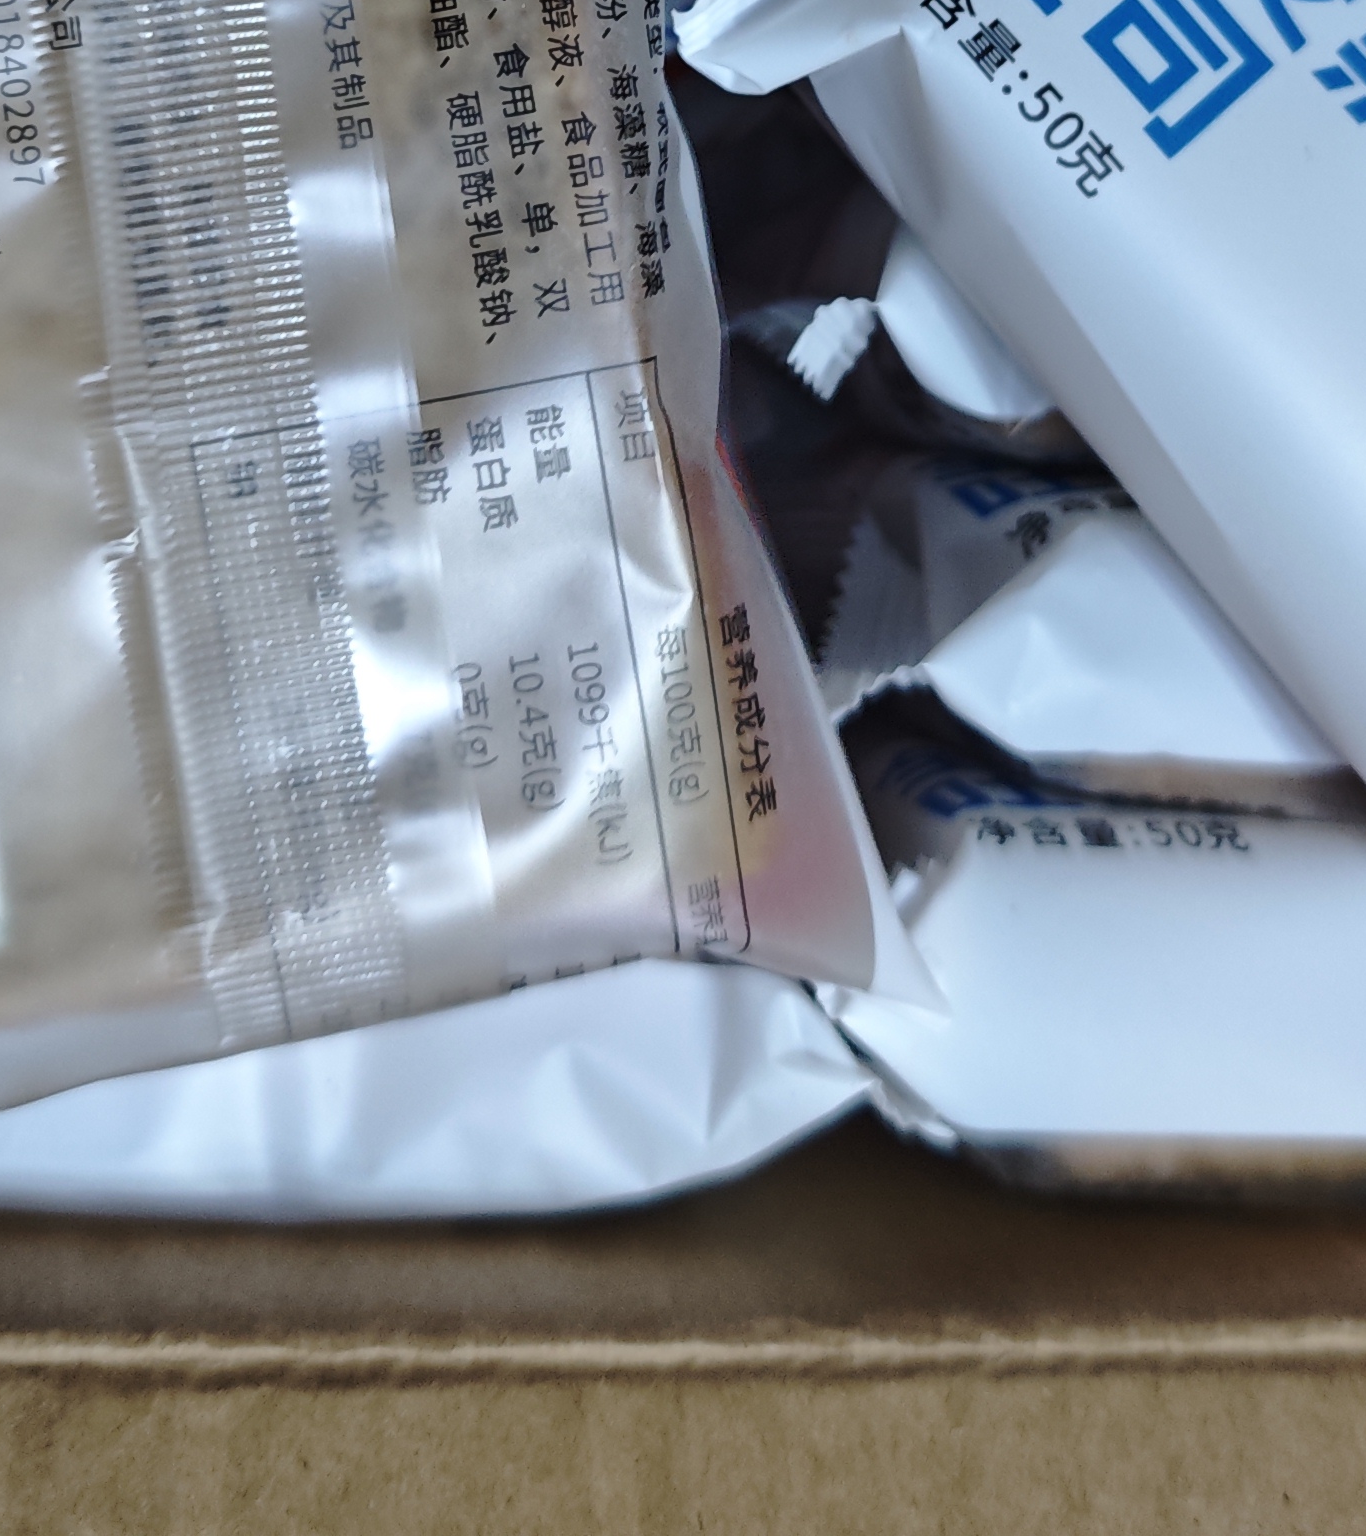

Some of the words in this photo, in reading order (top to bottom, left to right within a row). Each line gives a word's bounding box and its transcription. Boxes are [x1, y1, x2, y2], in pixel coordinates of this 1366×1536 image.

[404, 427, 458, 506] 脂肪
[464, 416, 520, 533] 蛋白质
[524, 404, 574, 483] 能量
[716, 602, 779, 823] 营养成分表
